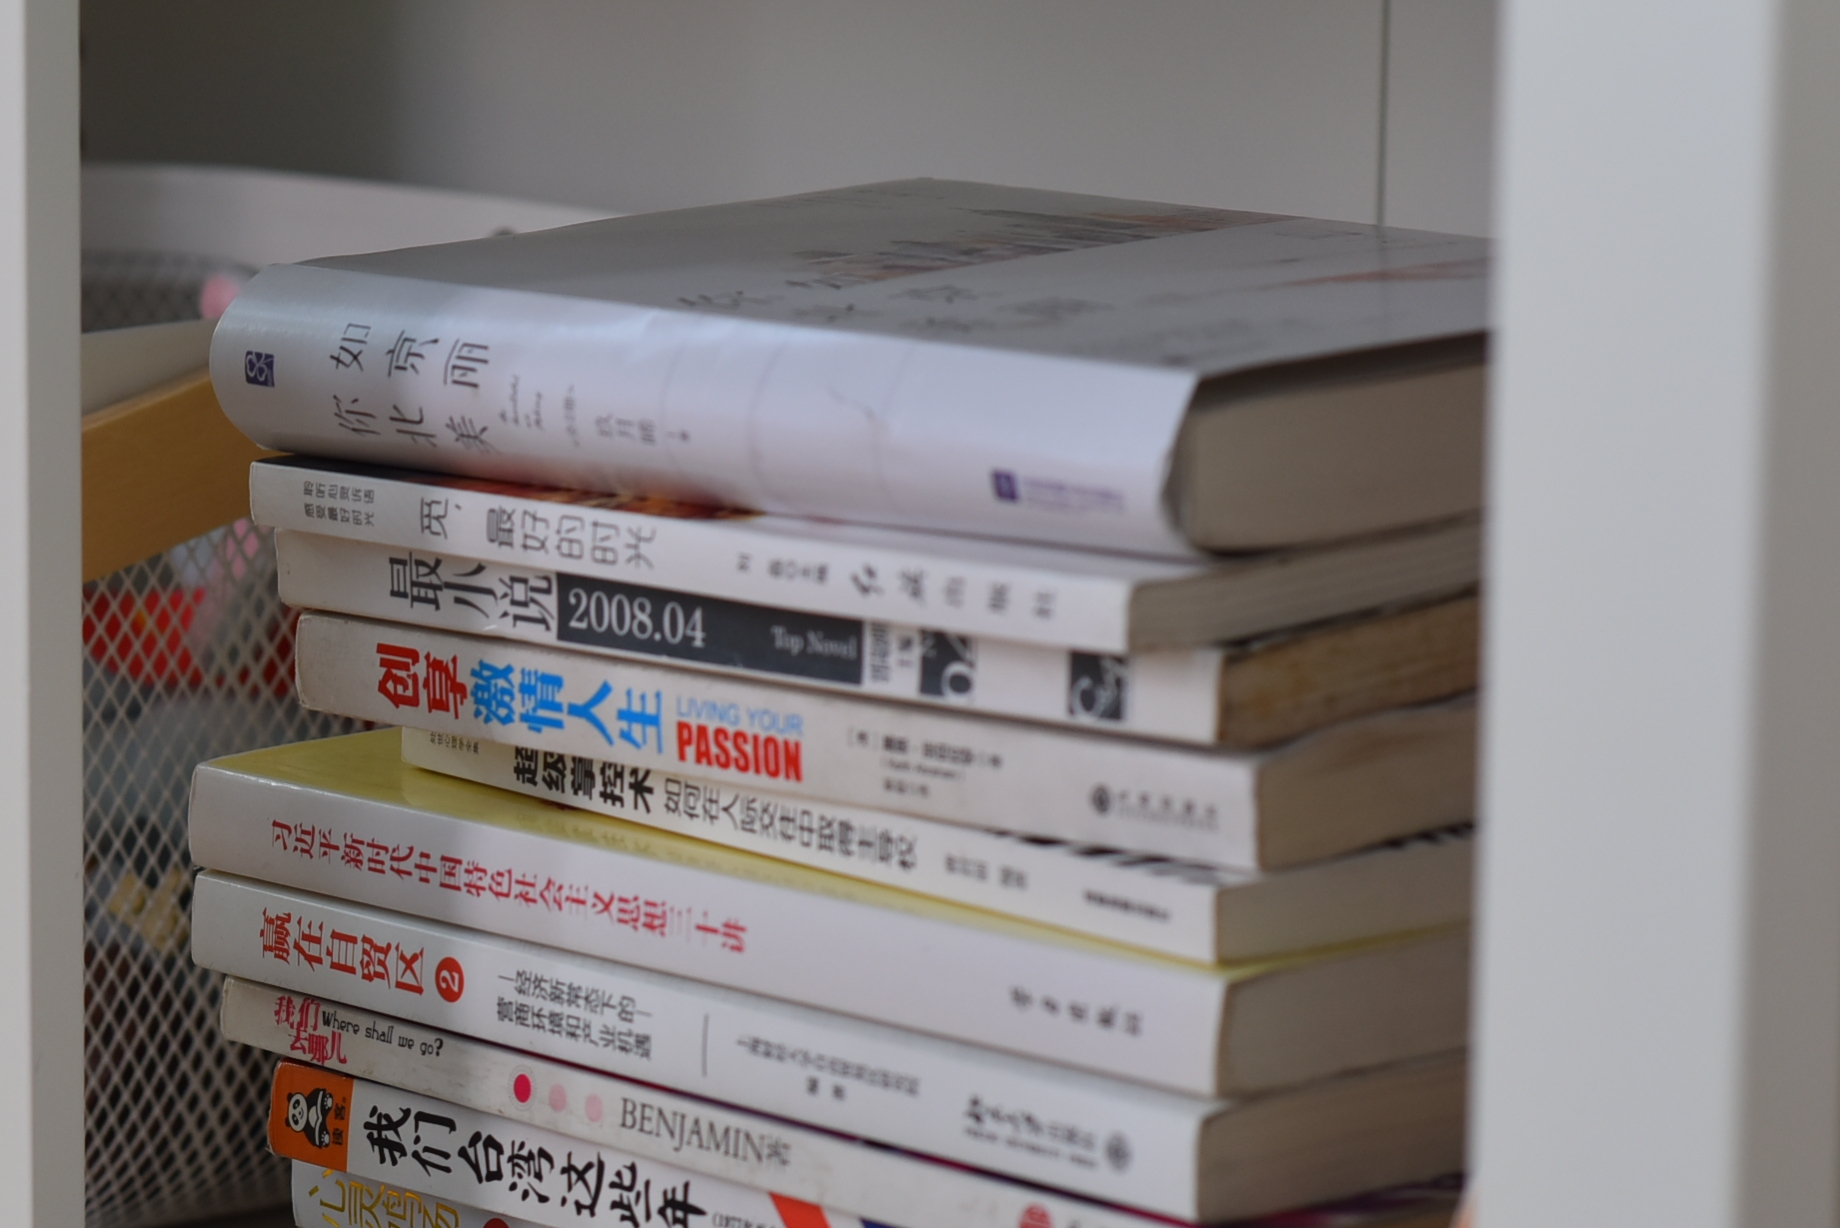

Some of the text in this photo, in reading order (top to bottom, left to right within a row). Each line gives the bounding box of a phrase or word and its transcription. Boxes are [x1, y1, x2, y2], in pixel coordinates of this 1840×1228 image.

[389, 552, 554, 632] 最小说
[568, 587, 707, 648] 2008.04
[771, 625, 802, 655] Top
[806, 631, 859, 660] Novel
[375, 642, 664, 754] 创享激情人生
[676, 695, 805, 736] LIVING YOUR
[676, 722, 804, 783] PASSION
[271, 819, 749, 956] 习近平新时代中国特色社会主义思想三十讲
[258, 907, 427, 997] 赢在自贸区
[275, 996, 322, 1031] 我们
[322, 1011, 445, 1060] Where shall we go?
[497, 997, 653, 1062] 营商环境和产业机遇
